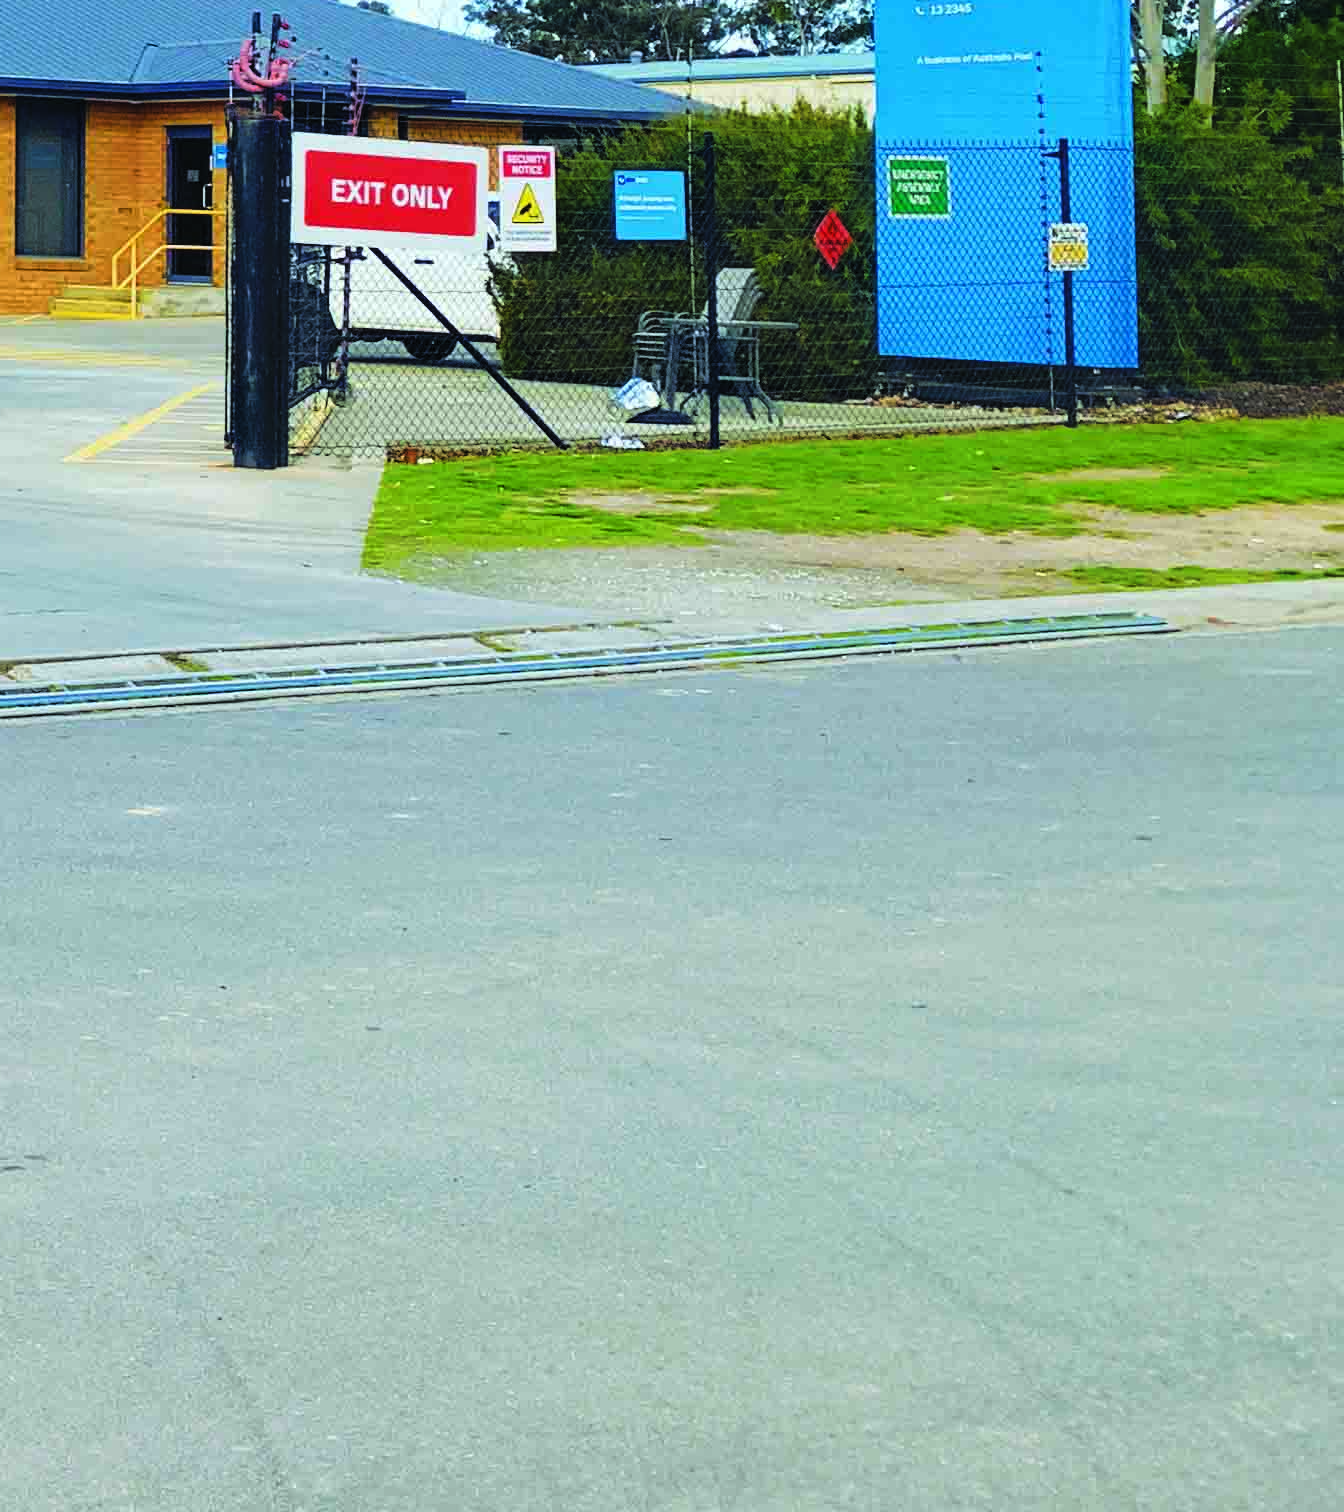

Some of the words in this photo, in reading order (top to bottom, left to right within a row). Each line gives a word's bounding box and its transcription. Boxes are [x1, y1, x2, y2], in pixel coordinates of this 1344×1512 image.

[511, 165, 545, 175] NOTICE
[331, 178, 386, 205] EXIT
[391, 183, 454, 210] ONLY
